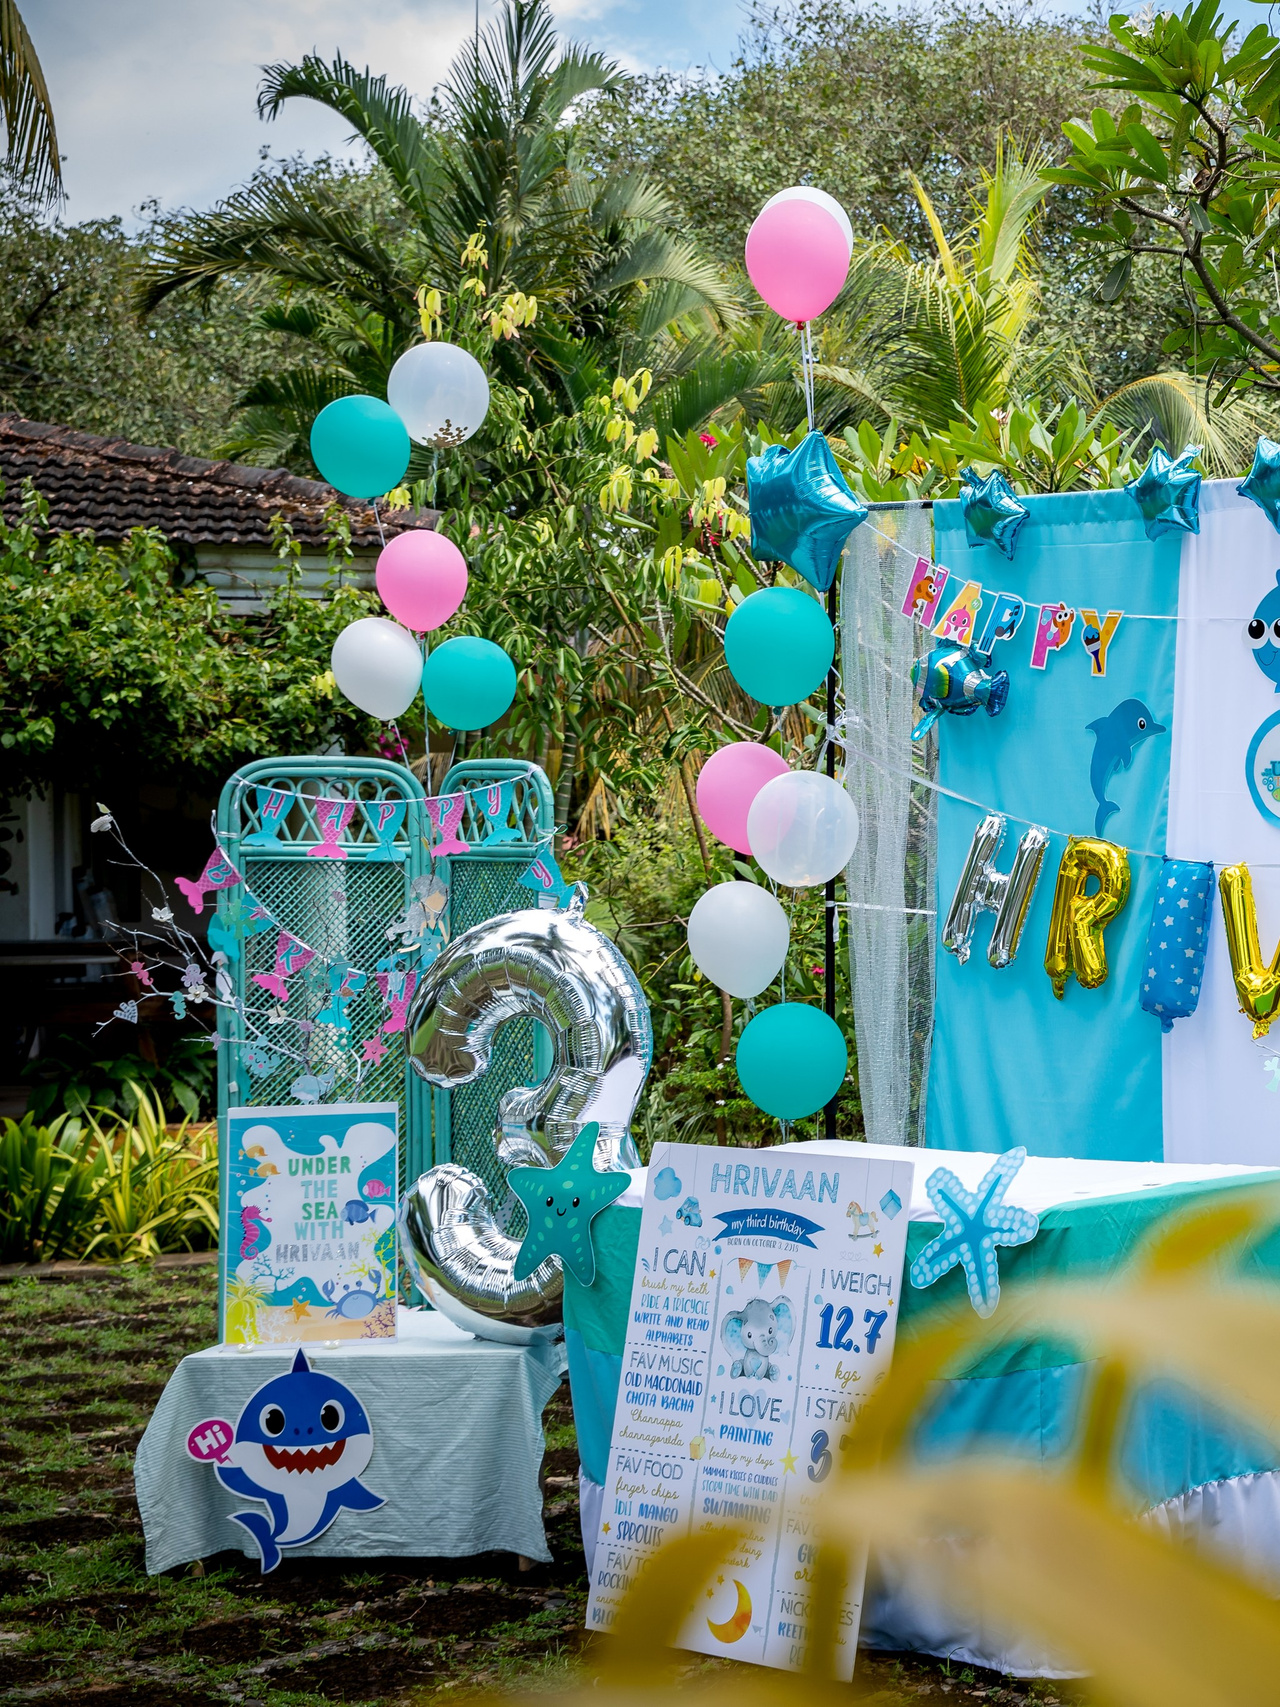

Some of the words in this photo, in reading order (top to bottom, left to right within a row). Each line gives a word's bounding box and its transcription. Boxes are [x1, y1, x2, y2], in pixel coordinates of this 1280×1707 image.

[901, 556, 1125, 677] HAPPY
[262, 786, 502, 832] HAPPY
[288, 1156, 351, 1177] UNDER
[300, 1179, 338, 1199] THE
[710, 1163, 840, 1204] HRIVAAN
[301, 1201, 339, 1221] SEA
[294, 1220, 345, 1241] WITH
[731, 1219, 746, 1234] my
[746, 1213, 767, 1228] third
[768, 1214, 806, 1241] birthday
[275, 1242, 360, 1264] HRIVAAN
[652, 1246, 659, 1272] I
[663, 1248, 707, 1277] CAN
[641, 1275, 668, 1291] brush
[670, 1282, 685, 1297] my
[687, 1280, 709, 1295] teeth
[820, 1268, 826, 1289] I
[830, 1269, 892, 1296] WEIGH
[641, 1293, 661, 1309] RIDE
[662, 1296, 670, 1311] A
[672, 1296, 711, 1315] TRICYCLE
[634, 1310, 662, 1326] WRITE
[664, 1314, 683, 1329] AND
[686, 1317, 710, 1332] READ
[815, 1302, 888, 1355] 12.7
[645, 1328, 694, 1347] ALPHABETS
[629, 1350, 657, 1370] FAV
[657, 1354, 704, 1377] MUSIC
[834, 1360, 862, 1390] kgs
[624, 1371, 642, 1388] OLD
[643, 1374, 703, 1396] MACDONALD
[625, 1390, 657, 1408] CHOTA
[660, 1394, 695, 1413] BACHA
[718, 1390, 725, 1414] I
[728, 1391, 783, 1423] LOVE
[805, 1396, 811, 1417] I
[194, 1424, 227, 1456] Hi
[719, 1424, 774, 1447] PAINTING
[615, 1454, 642, 1474] FAV
[643, 1458, 684, 1480] FOOD
[708, 1446, 738, 1465] feeding
[740, 1455, 753, 1468] my
[755, 1453, 775, 1470] dogs
[729, 1469, 747, 1482] KISSES
[753, 1474, 779, 1487] CUDDLES
[615, 1476, 648, 1499] finger
[651, 1482, 680, 1505] chips
[701, 1479, 723, 1494] STORY
[724, 1482, 741, 1497] TIME
[742, 1485, 760, 1500] WITH
[761, 1489, 779, 1503] DAD
[614, 1498, 633, 1516] IDLI
[637, 1502, 679, 1524] MANGO
[702, 1497, 772, 1525] SWIMMING
[616, 1520, 665, 1547] SPROUTS
[606, 1551, 633, 1571] FAV
[739, 1542, 763, 1561] doing
